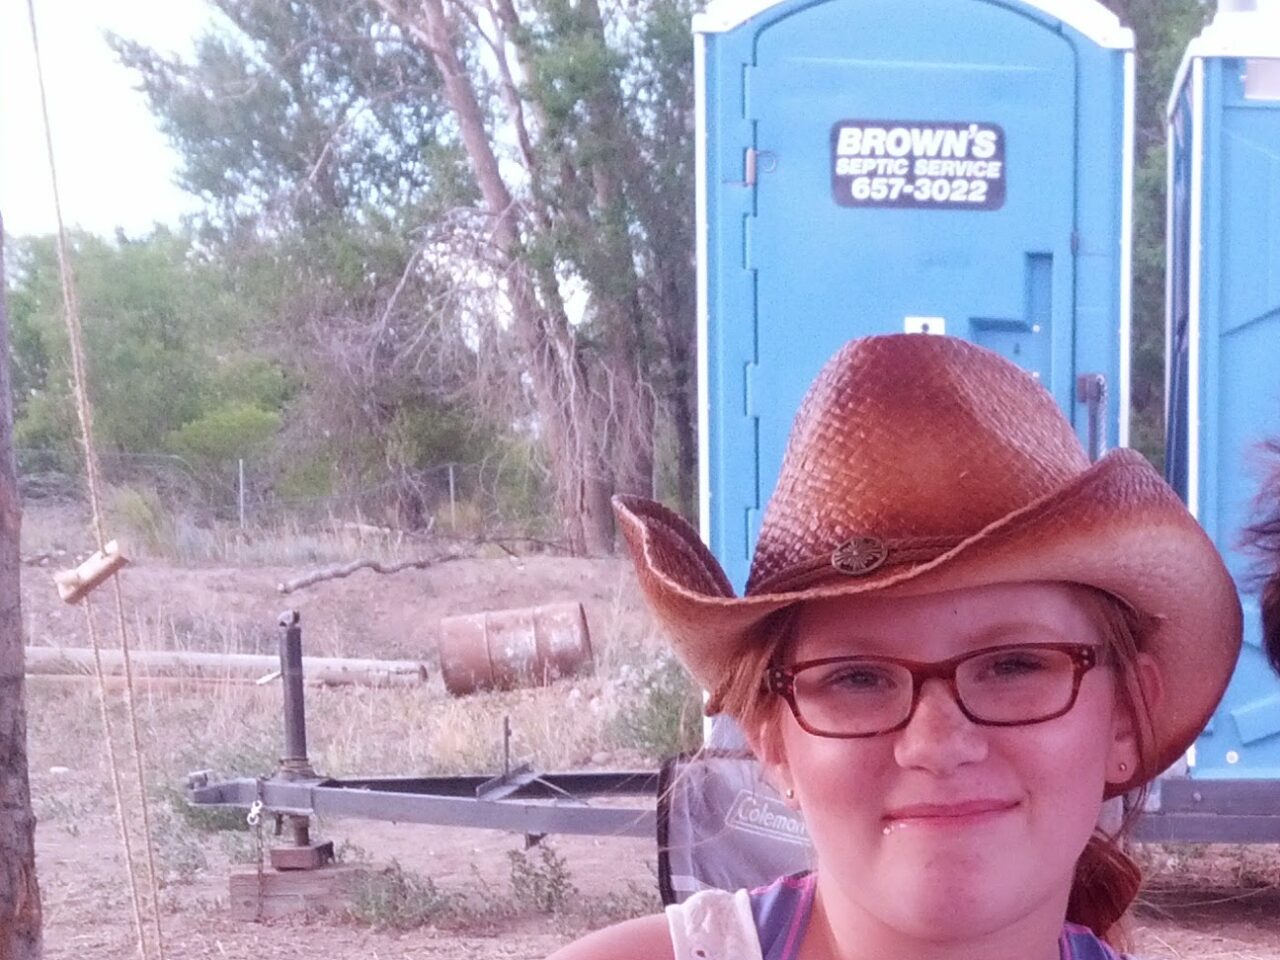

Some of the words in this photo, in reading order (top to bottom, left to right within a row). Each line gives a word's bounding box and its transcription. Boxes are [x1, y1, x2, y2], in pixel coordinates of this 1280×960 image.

[837, 124, 997, 158] BROWN'S
[836, 158, 909, 175] SEPTIC
[914, 159, 1002, 178] SERVICE
[851, 177, 988, 202] 657-3022
